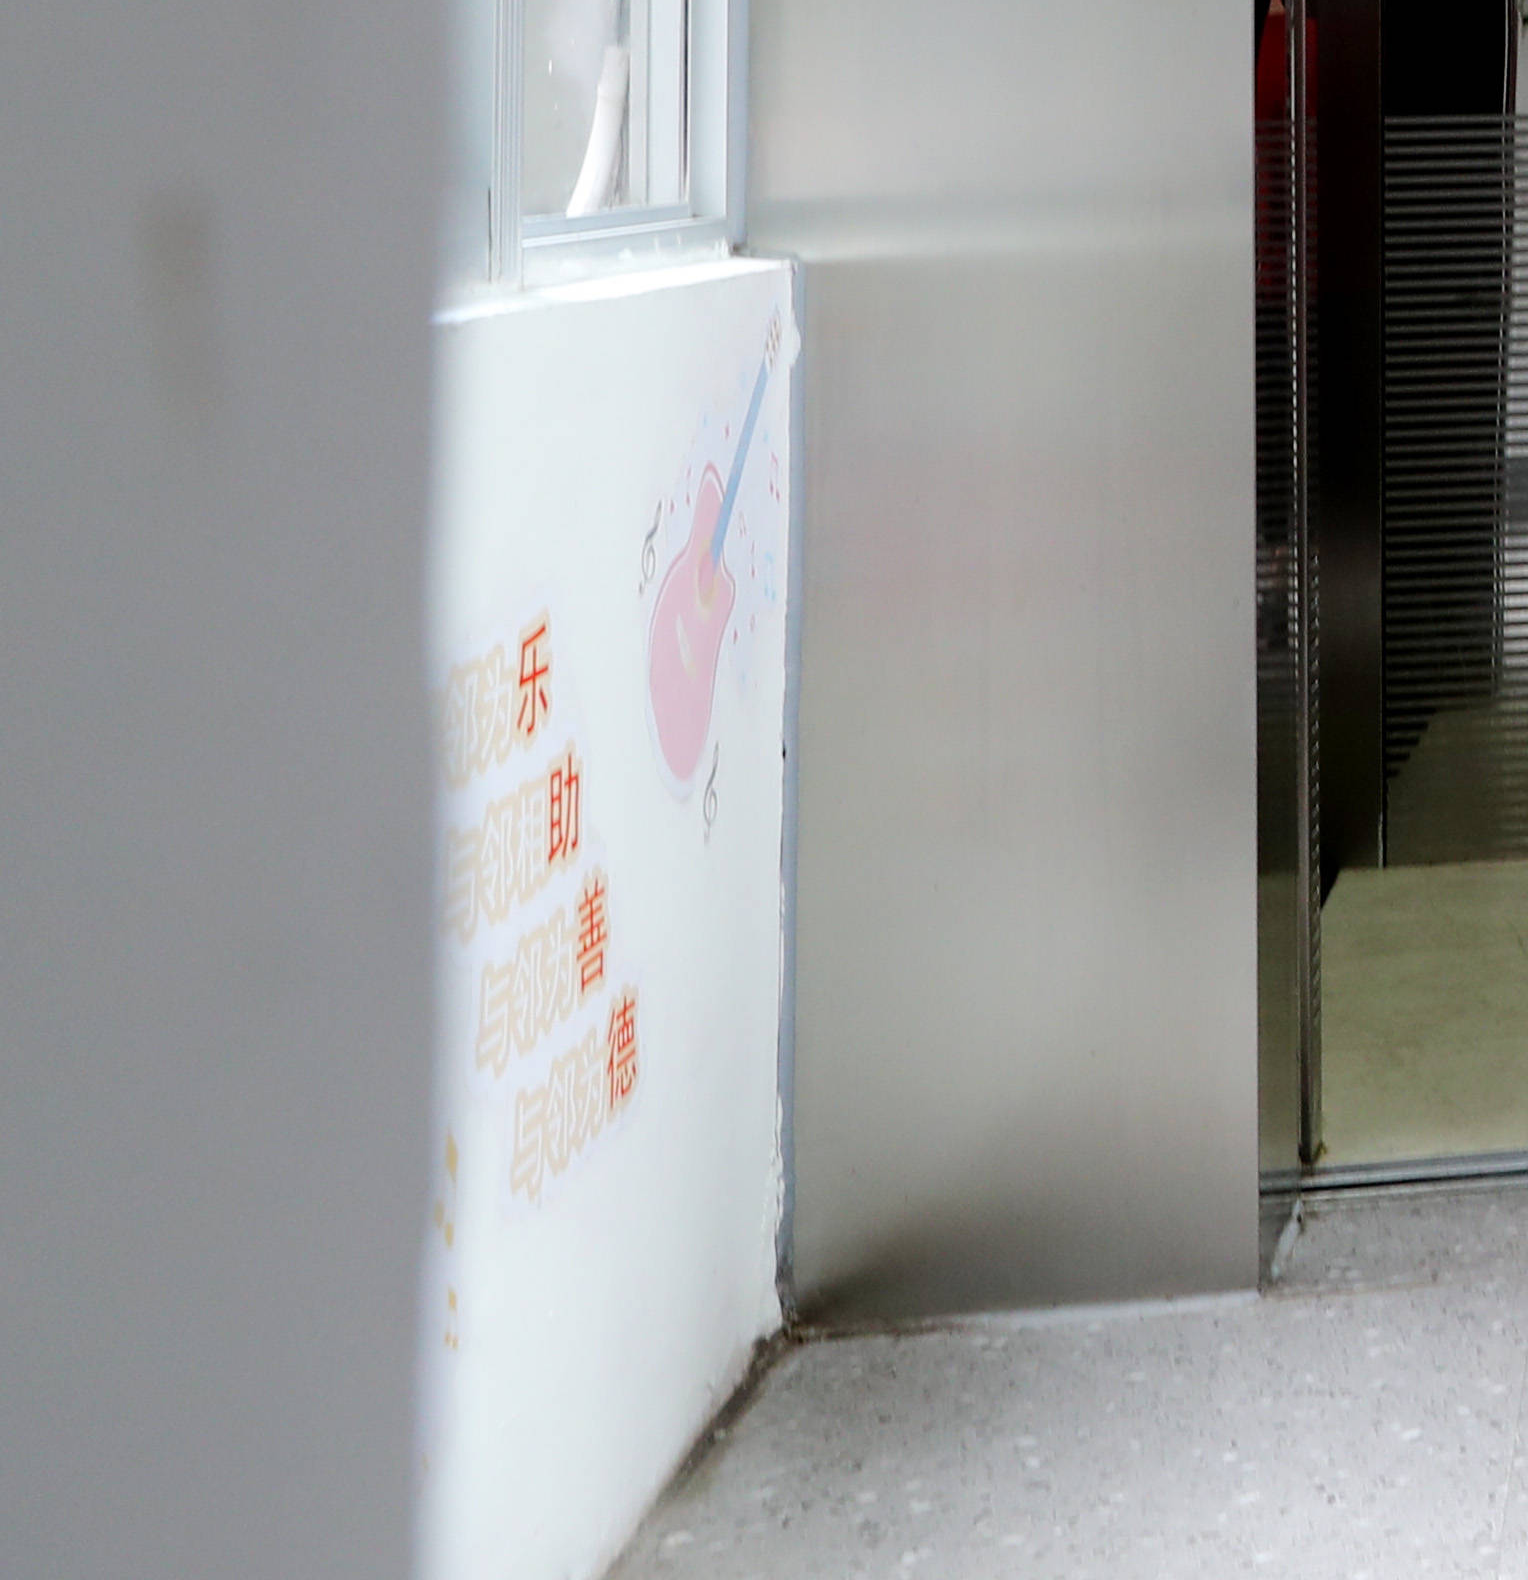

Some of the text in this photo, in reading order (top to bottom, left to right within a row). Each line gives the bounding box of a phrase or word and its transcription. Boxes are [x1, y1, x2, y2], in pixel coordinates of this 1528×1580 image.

[443, 623, 550, 780] 邻为乐
[478, 878, 608, 1070] 与邻为善
[513, 994, 638, 1196] 与邻为德
